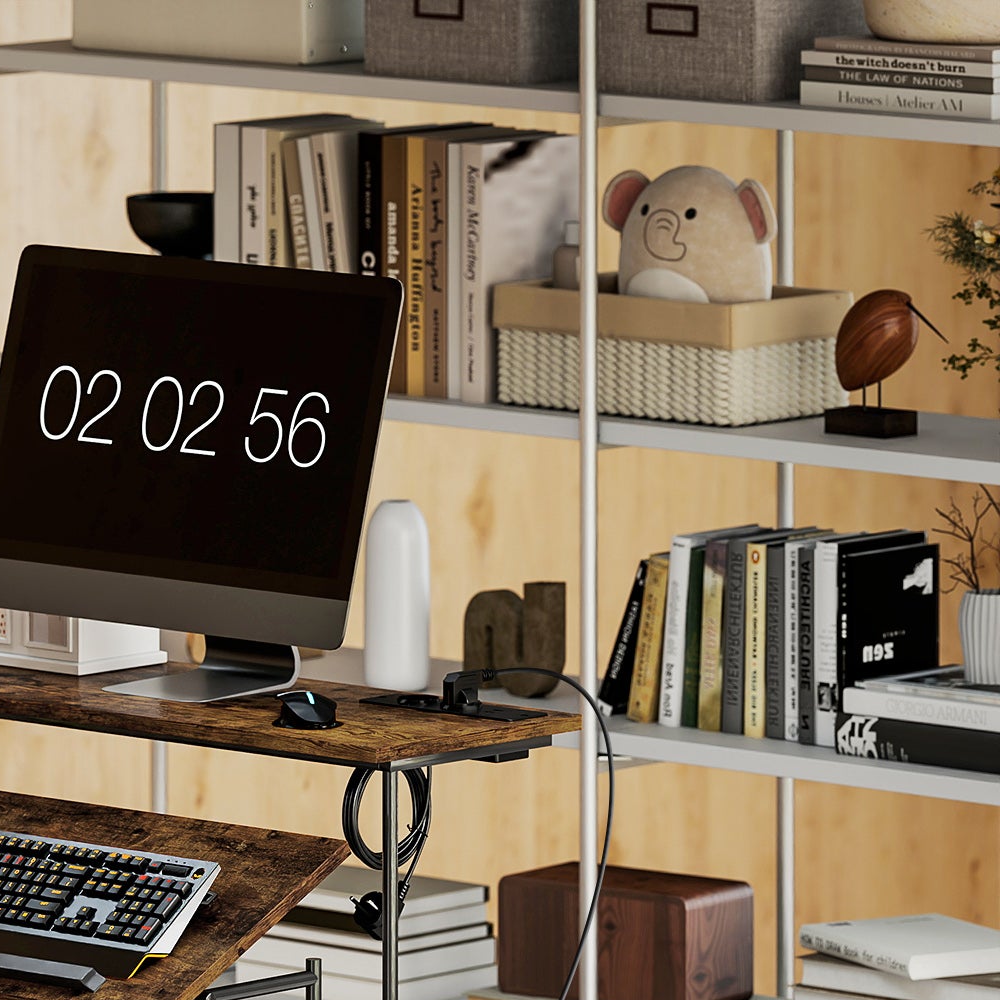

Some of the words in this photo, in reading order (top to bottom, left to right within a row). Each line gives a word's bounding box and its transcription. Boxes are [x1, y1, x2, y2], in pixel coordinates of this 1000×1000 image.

[835, 55, 855, 66] the
[856, 57, 889, 69] witch
[890, 59, 936, 72] doesn't
[937, 62, 966, 73] burn
[839, 70, 861, 82] THE
[865, 72, 890, 83] LAW
[893, 74, 908, 84] OF
[912, 76, 964, 89] NATIONS
[838, 90, 882, 106] Houses
[894, 95, 935, 110] Atelier
[466, 165, 480, 205] Karen
[387, 201, 400, 264] amanda
[410, 183, 423, 251] Arianna
[465, 209, 480, 282] McCartney
[409, 258, 423, 352] Huffington
[40, 365, 122, 445] 02
[141, 376, 224, 456] 02
[244, 387, 330, 468] 56
